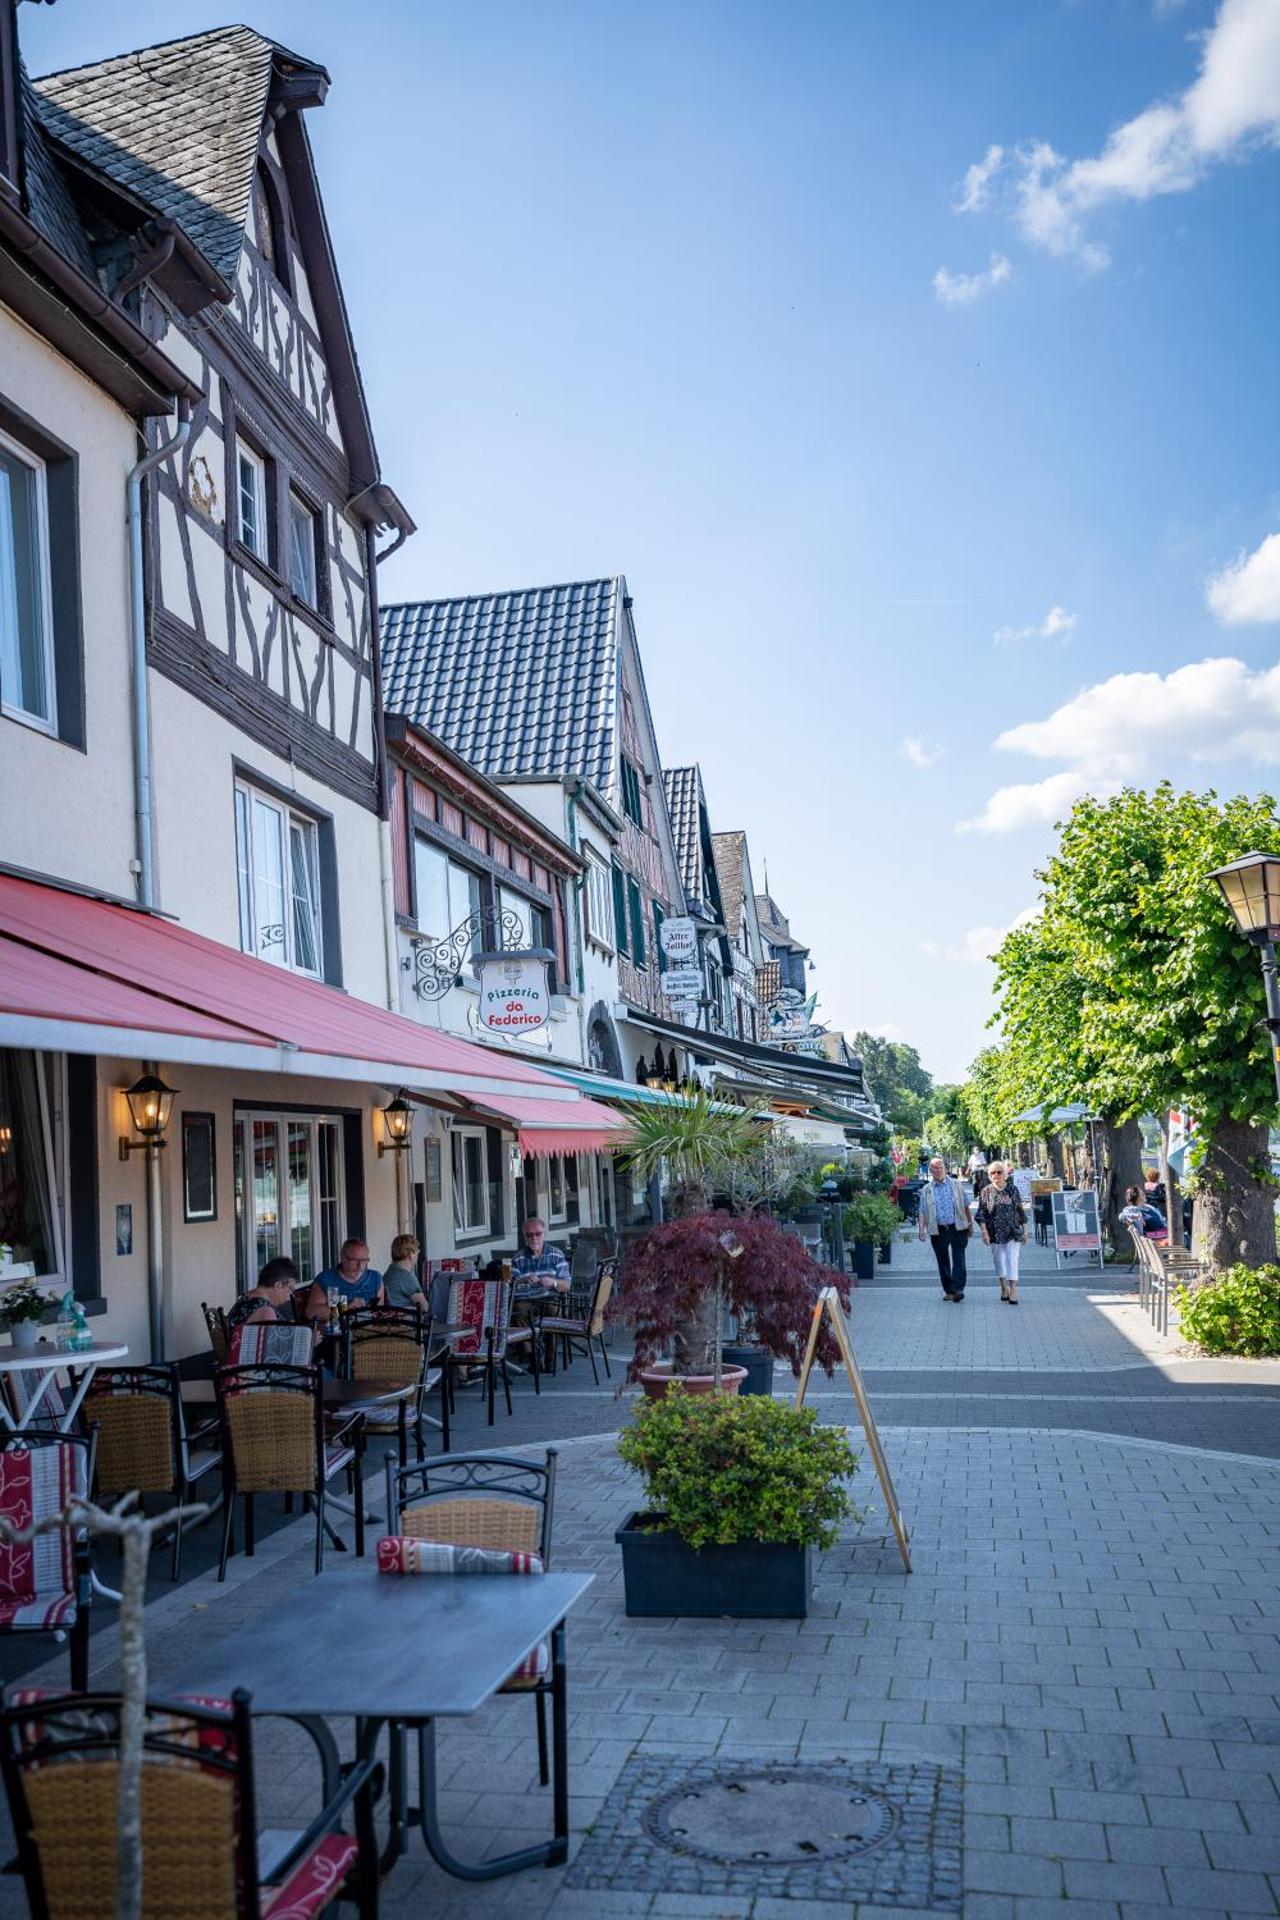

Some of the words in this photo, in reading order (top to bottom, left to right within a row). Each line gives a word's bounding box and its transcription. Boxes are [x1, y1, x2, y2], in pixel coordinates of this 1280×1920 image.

[667, 933, 689, 942] Alter
[487, 987, 539, 1002] Pizzeria
[506, 1001, 523, 1012] da
[488, 1013, 541, 1026] Federico
